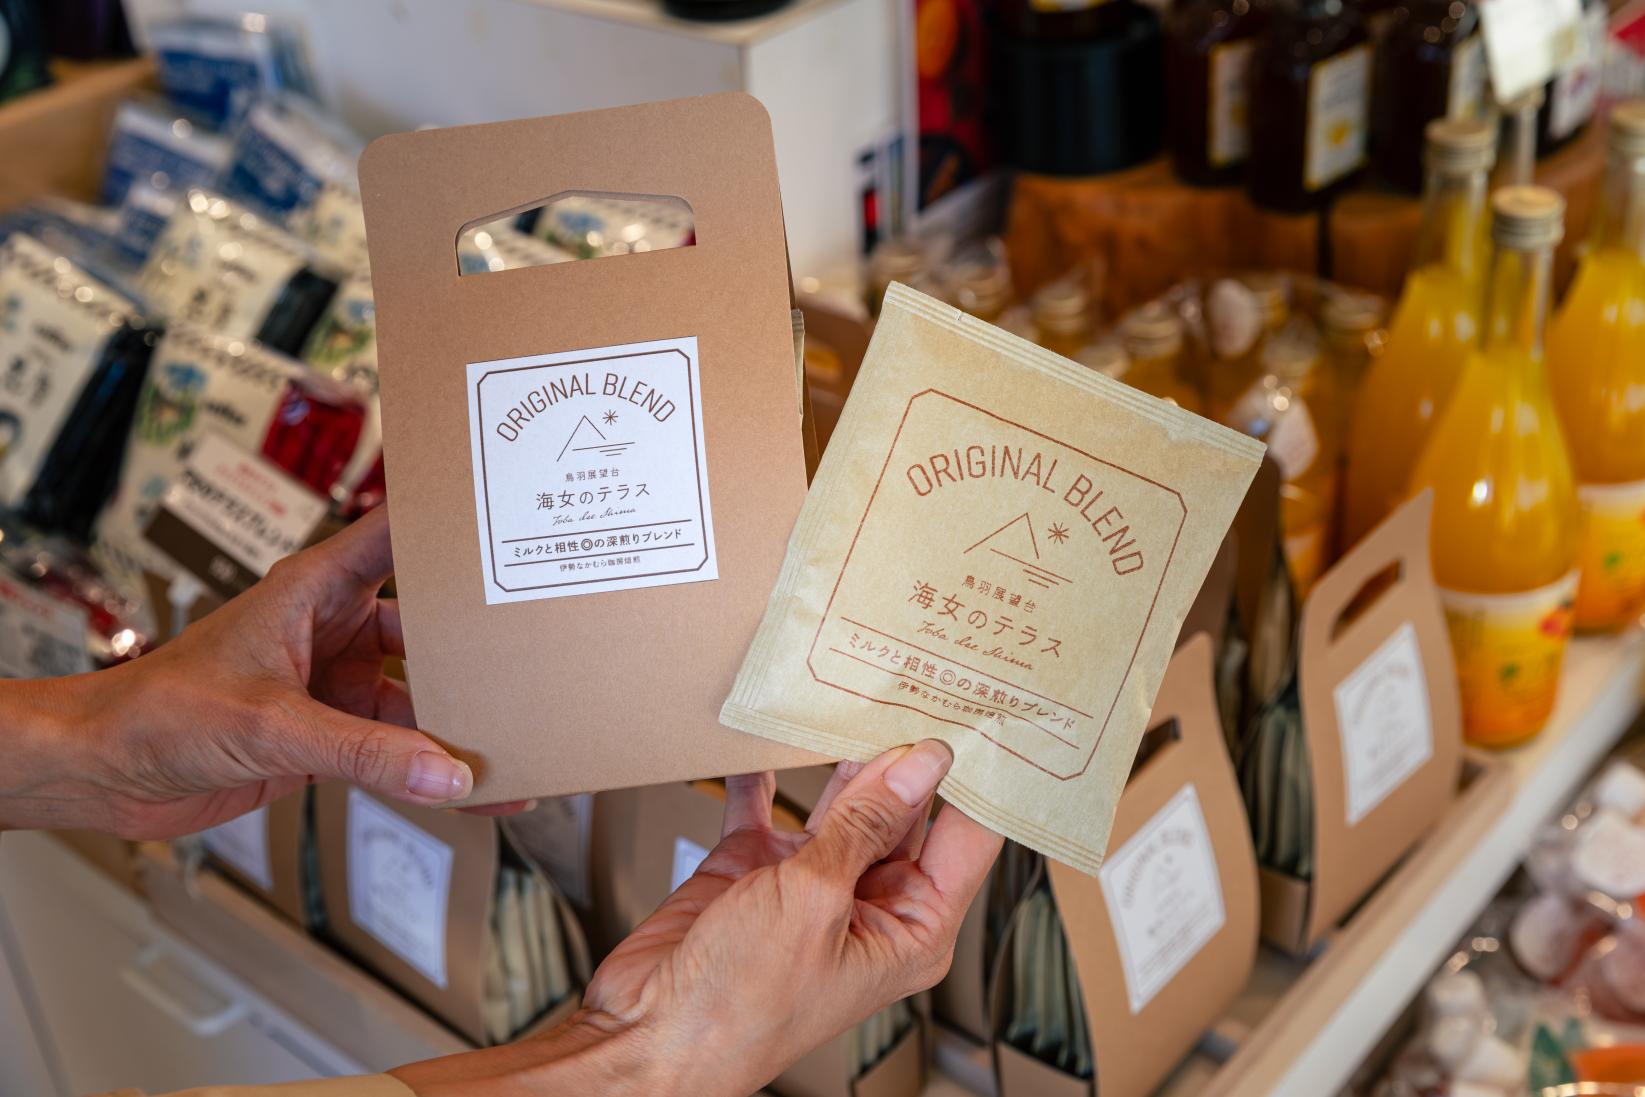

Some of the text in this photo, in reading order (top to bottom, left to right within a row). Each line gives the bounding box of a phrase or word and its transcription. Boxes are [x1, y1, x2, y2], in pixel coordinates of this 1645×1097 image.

[496, 373, 676, 442] ORIGINAL BLEND
[536, 483, 651, 511] 海女のテラス
[565, 467, 621, 483] 鳥羽展望台
[906, 445, 1144, 576] ORIGINAL BLEND
[908, 580, 1063, 658] 海女のテラス
[961, 575, 1037, 613] 鳥羽展望台
